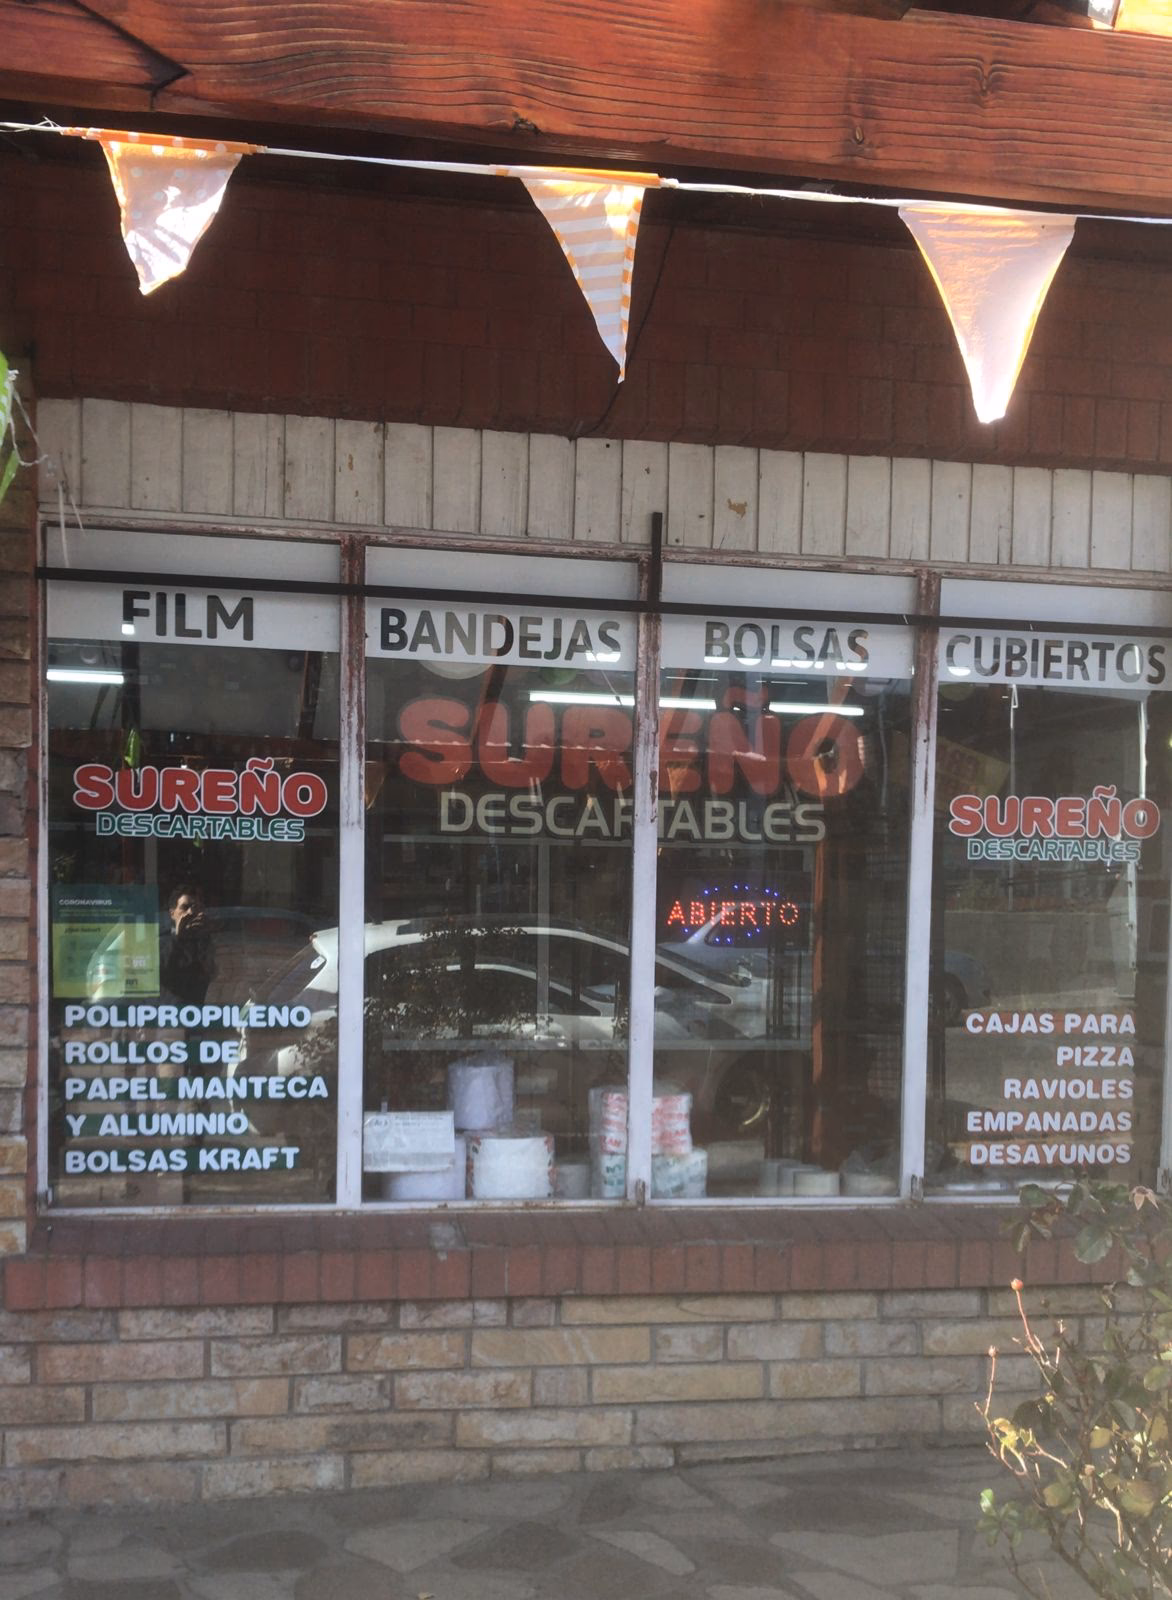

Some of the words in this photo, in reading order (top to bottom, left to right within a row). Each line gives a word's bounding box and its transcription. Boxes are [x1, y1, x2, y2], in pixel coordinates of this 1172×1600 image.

[122, 590, 254, 641] FILM
[380, 607, 621, 662] BANDEJAS
[704, 621, 869, 671] BOLSAS
[946, 634, 1166, 685] CUBIERTOS
[398, 687, 866, 798] SUREÑO
[73, 757, 328, 817] SUREÑO
[949, 785, 1160, 839] SUREÑO
[96, 812, 305, 842] DESCARTABLES
[967, 838, 1141, 862] DESCARTABLES
[667, 900, 799, 926] ABIERTO
[65, 1004, 311, 1028] POLIPROPILENO
[965, 1013, 1054, 1034] CAJAS
[1064, 1013, 1136, 1034] PARA
[65, 1041, 188, 1064] ROLLOS
[200, 1041, 239, 1063] DE
[1057, 1046, 1135, 1067] PIZZA
[65, 1077, 166, 1100] PAPEL
[178, 1076, 328, 1099] MANTECA
[1004, 1078, 1133, 1099] RAVIOLES
[65, 1114, 87, 1136] Y
[99, 1112, 249, 1136] ALUMINIO
[967, 1111, 1132, 1132] EMPANADAS
[65, 1149, 188, 1173] BOLSAS
[199, 1147, 300, 1170] KRAFT
[970, 1144, 1131, 1165] DESAYUNOS
